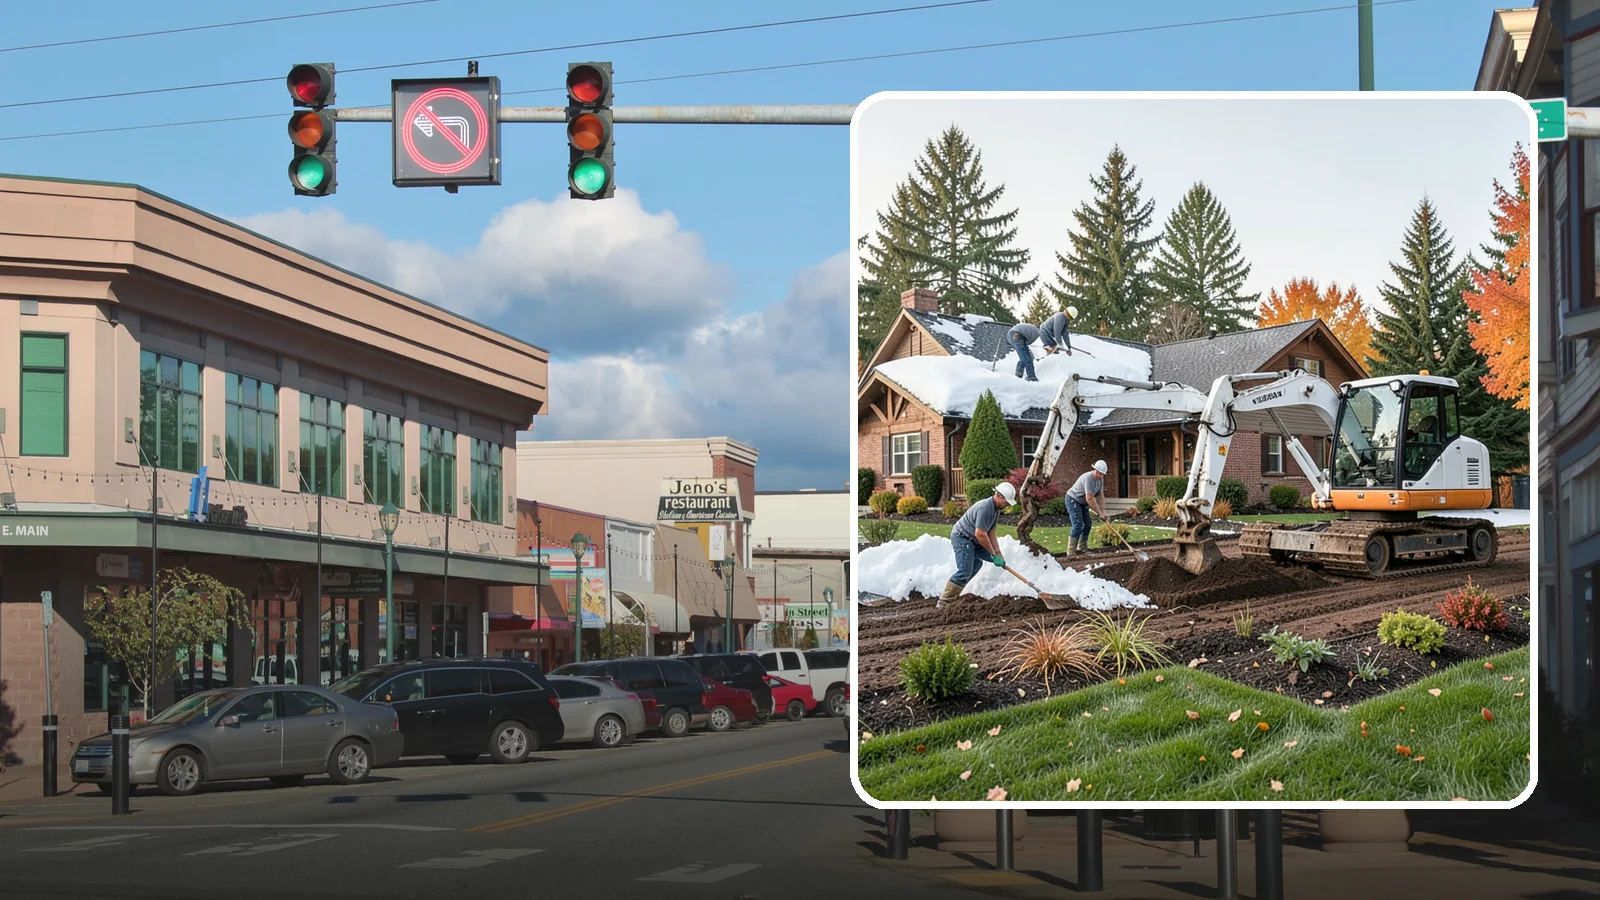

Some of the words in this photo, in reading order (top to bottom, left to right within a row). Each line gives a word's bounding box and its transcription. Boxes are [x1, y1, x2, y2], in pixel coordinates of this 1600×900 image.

[669, 480, 728, 495] Jeno's
[664, 496, 731, 509] restaurant
[658, 510, 682, 520] Italian
[686, 509, 715, 520] American
[714, 509, 738, 520] Cuisine
[2, 525, 13, 536] E.
[15, 525, 49, 536] MAIN
[797, 607, 828, 617] Street
[790, 619, 823, 627] lass
